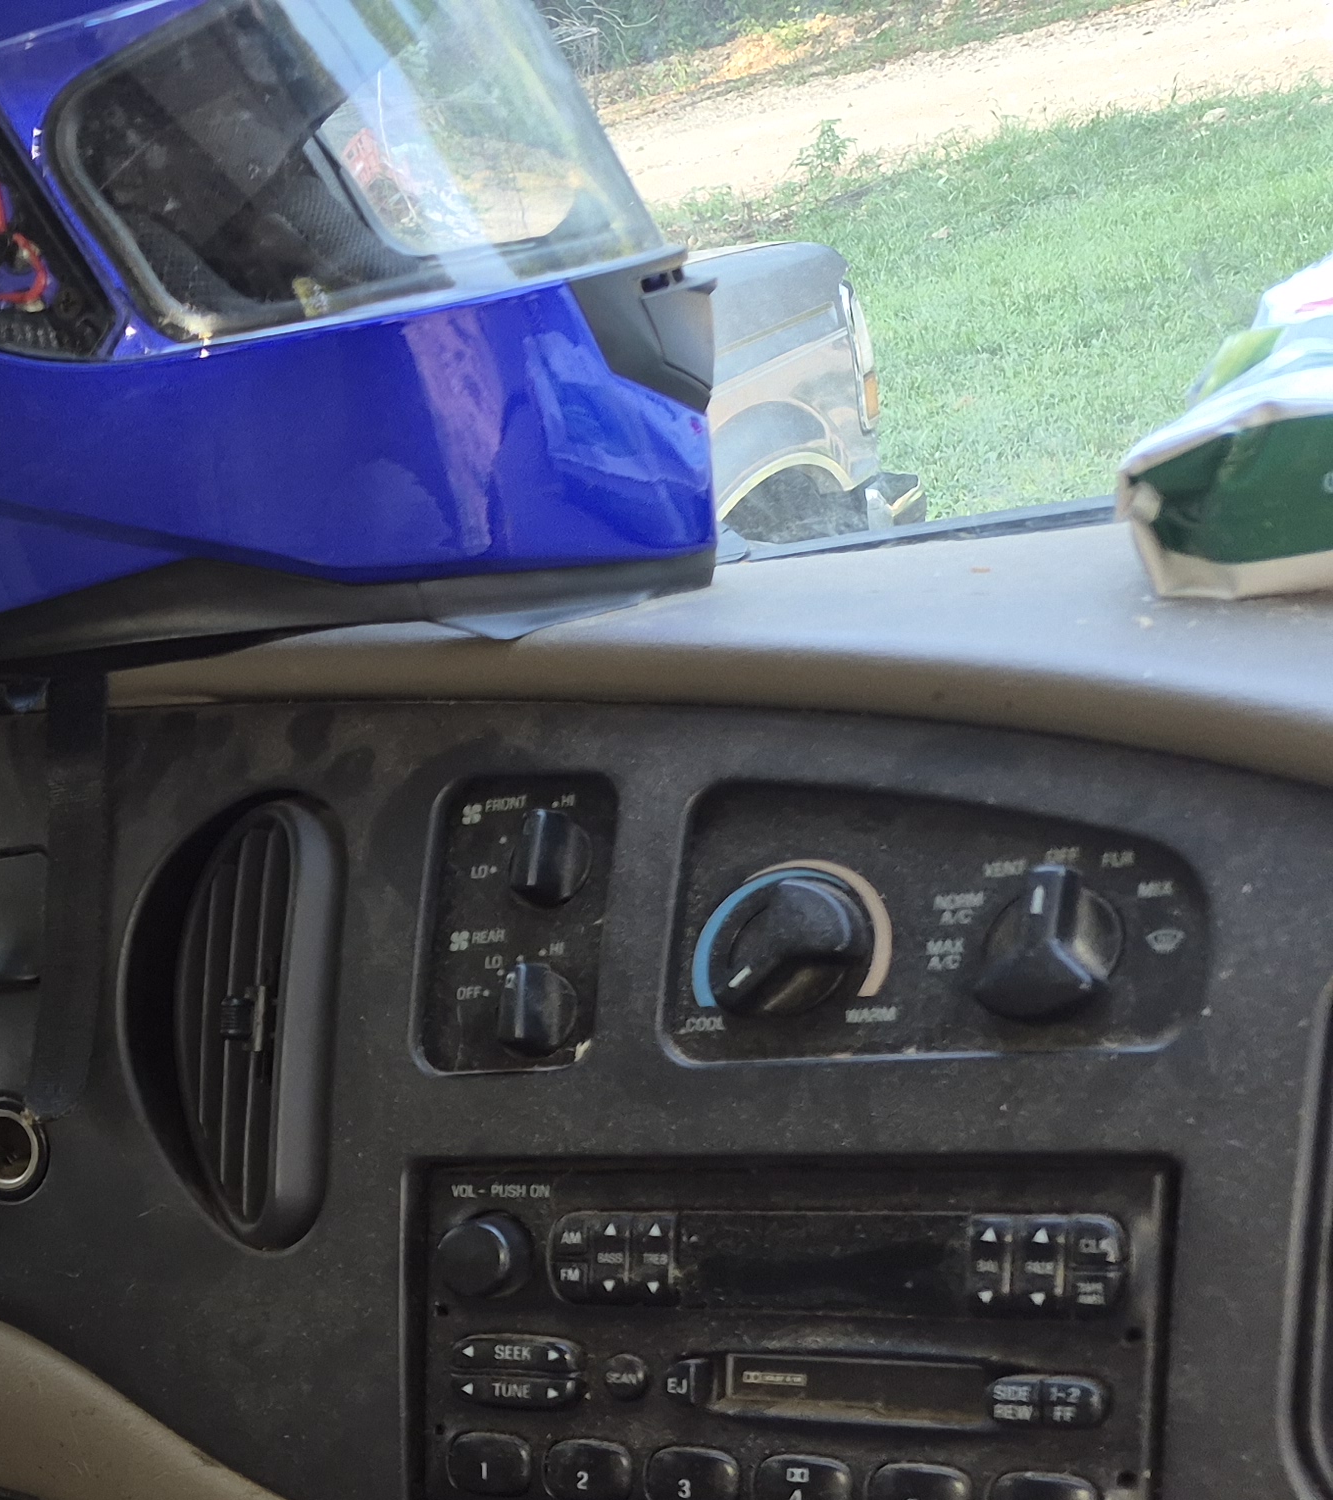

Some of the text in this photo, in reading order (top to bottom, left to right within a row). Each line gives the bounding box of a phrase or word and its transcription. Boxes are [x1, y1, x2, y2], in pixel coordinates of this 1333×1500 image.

[485, 795, 527, 812] FRONT
[471, 866, 489, 878] LO
[484, 954, 503, 969] LO
[456, 986, 482, 1000] OFF
[451, 1185, 477, 1198] VOL
[491, 1185, 526, 1198] PUSH
[529, 1184, 550, 1198] ON
[561, 1231, 582, 1244] AM
[597, 1252, 624, 1264] BASS
[643, 1252, 668, 1265] TREB
[560, 1268, 580, 1282] FM
[494, 1344, 531, 1360] SEEK
[606, 1371, 637, 1385] SCAN
[492, 1382, 531, 1399] TUNE
[667, 1377, 688, 1394] EJ
[481, 1462, 488, 1480] 1
[577, 1471, 589, 1490] 2
[678, 1479, 692, 1499] 3
